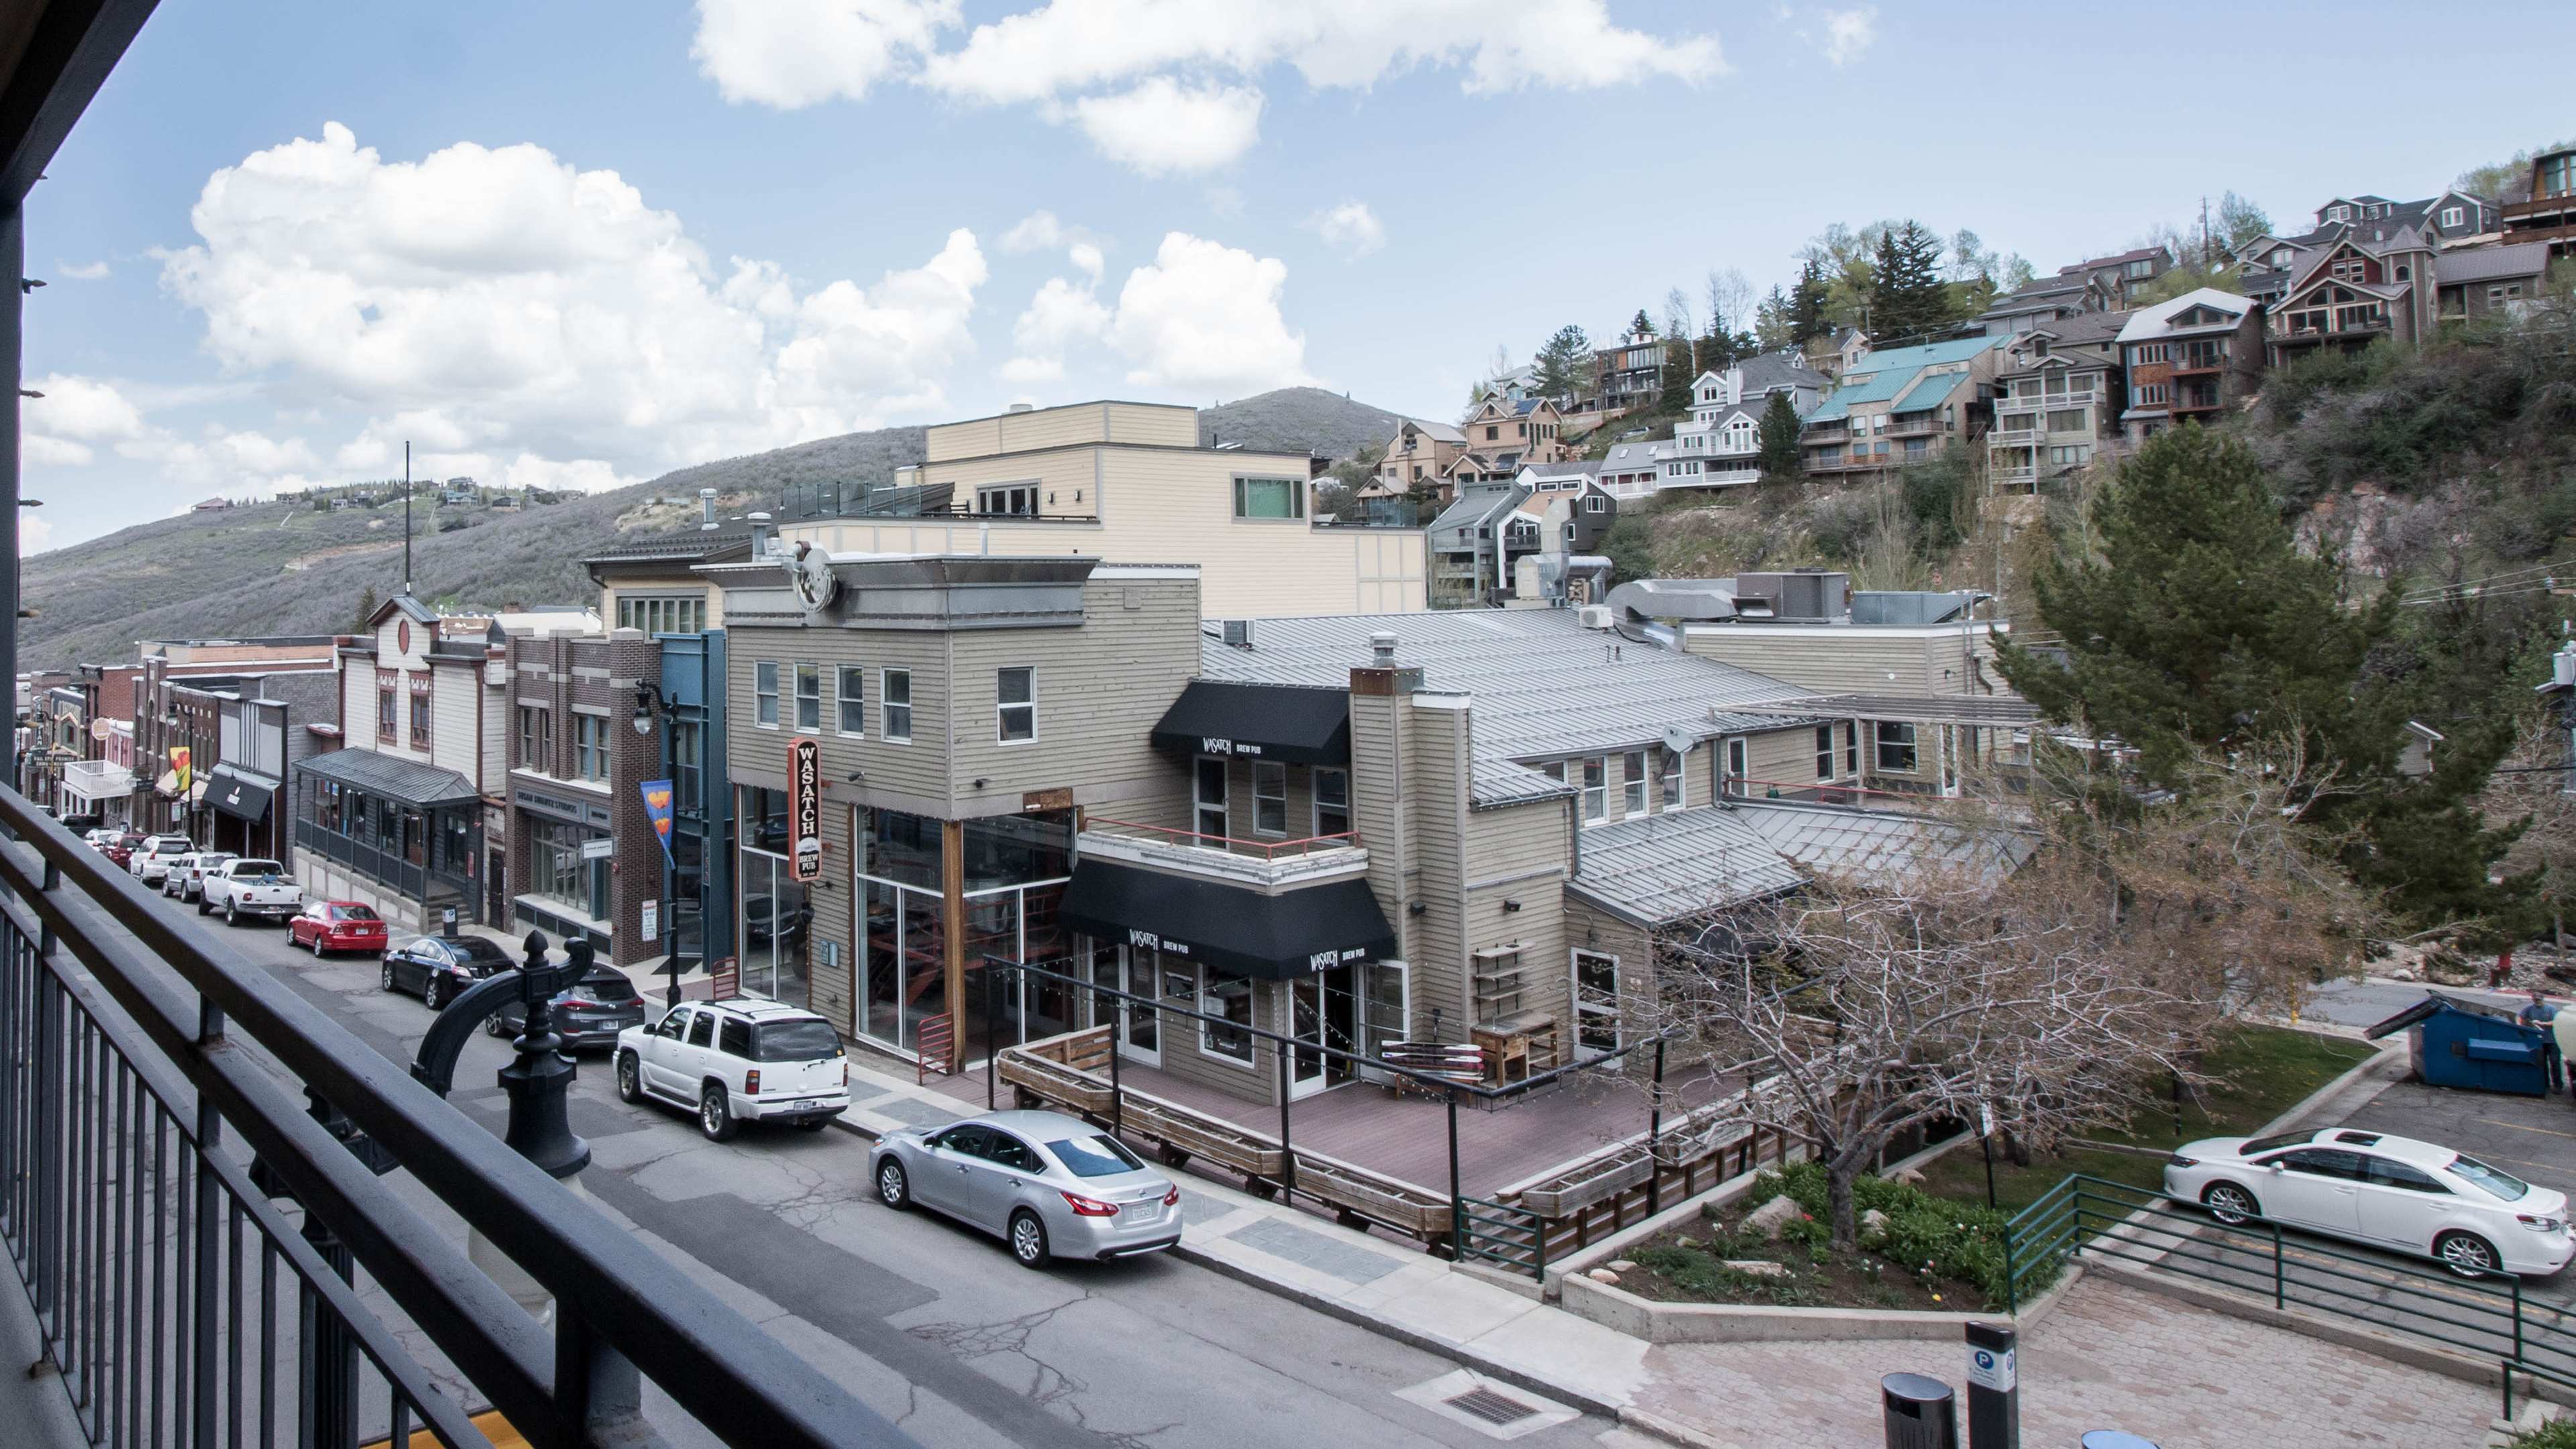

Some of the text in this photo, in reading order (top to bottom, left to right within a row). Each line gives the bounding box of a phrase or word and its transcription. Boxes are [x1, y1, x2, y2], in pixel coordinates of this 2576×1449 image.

[1203, 737, 1261, 755] WASATCH BREW PUB
[798, 747, 816, 835] WASATCH
[800, 854, 818, 863] BREW
[802, 862, 816, 871] PUB
[1129, 928, 1189, 954] WASATCH BREW PUB
[1310, 948, 1364, 972] WASATCH BREW PUB
